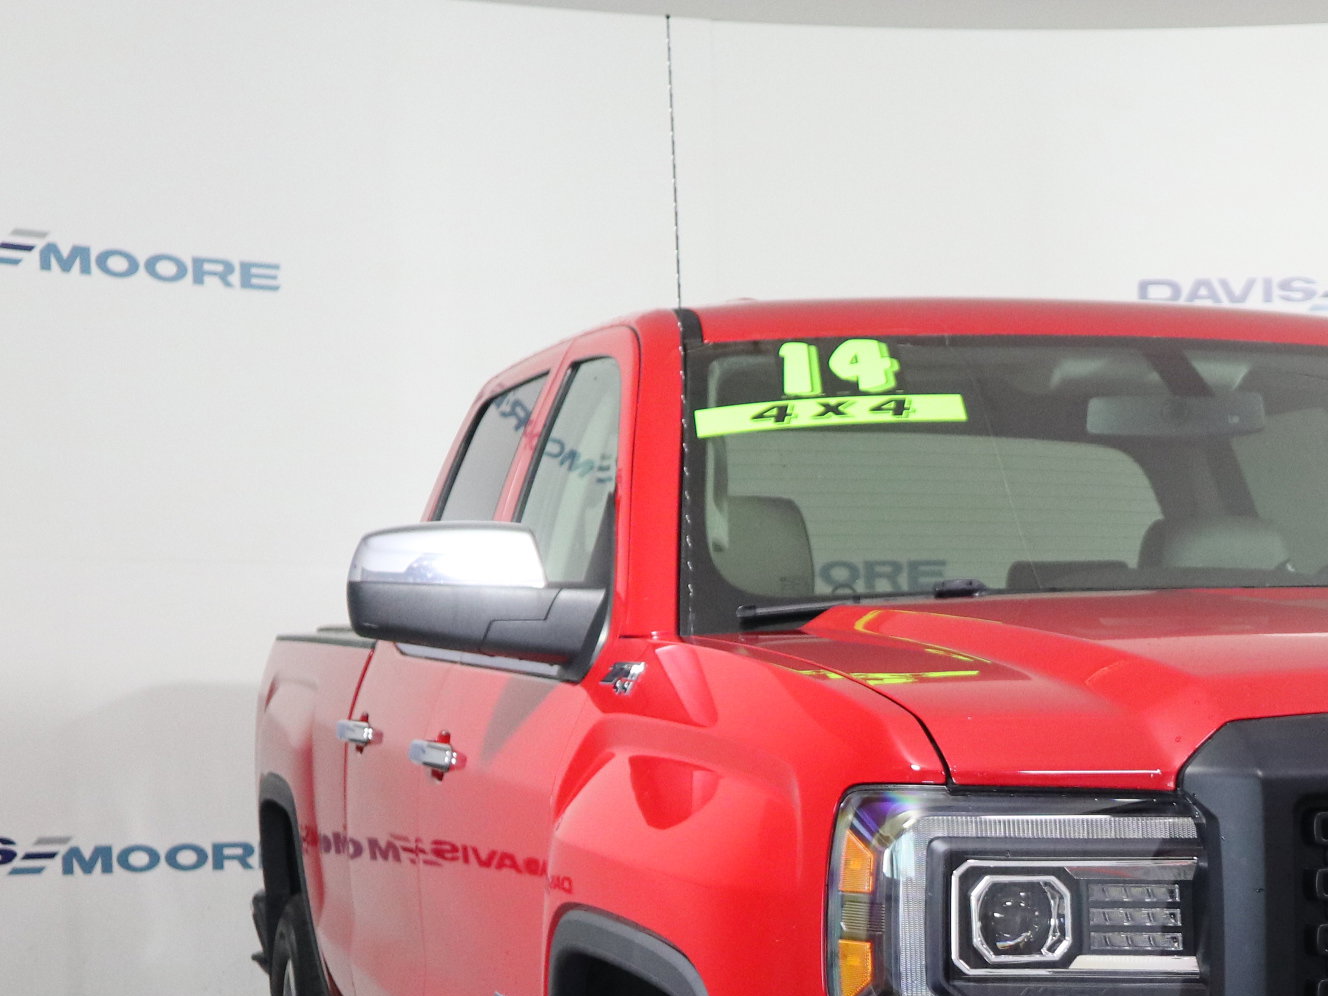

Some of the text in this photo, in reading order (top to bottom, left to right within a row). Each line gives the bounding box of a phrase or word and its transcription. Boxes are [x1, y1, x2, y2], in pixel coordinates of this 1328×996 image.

[38, 241, 281, 291] MOORE
[1137, 276, 1319, 303] DAVIS
[778, 338, 900, 394] 14
[818, 558, 948, 594] ORE
[61, 842, 262, 876] MOOR
